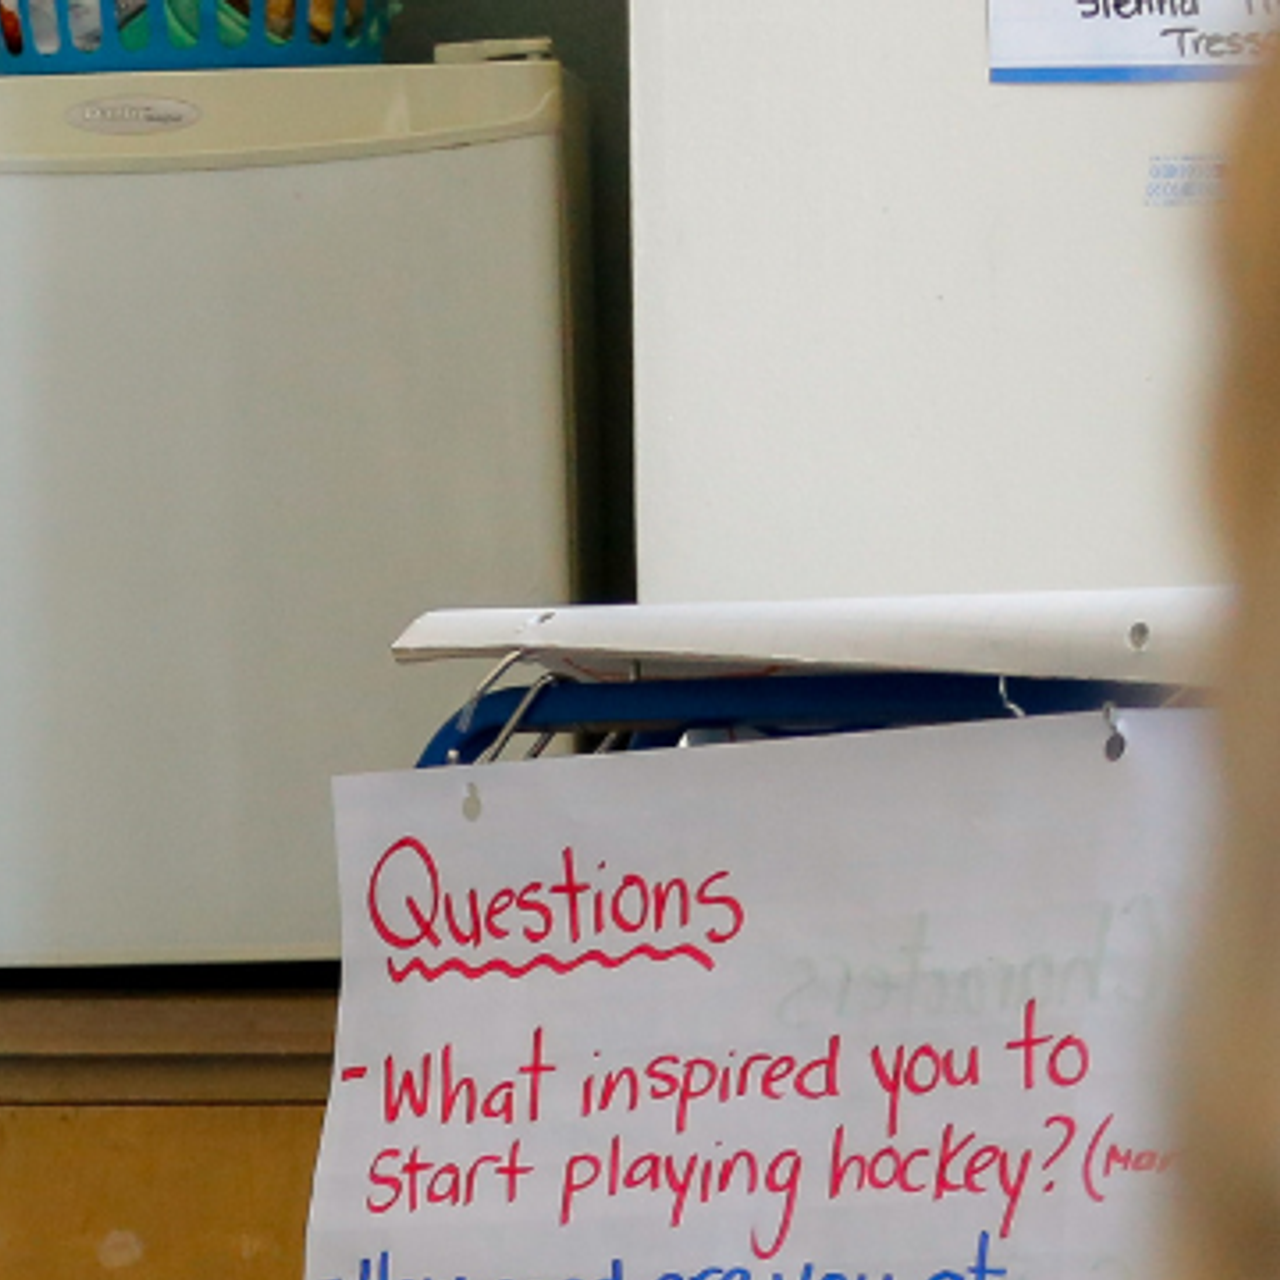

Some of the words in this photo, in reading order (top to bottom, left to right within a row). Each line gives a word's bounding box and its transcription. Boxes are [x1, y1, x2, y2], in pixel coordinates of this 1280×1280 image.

[368, 836, 745, 950] Questions
[582, 1033, 840, 1133] inspired
[871, 1041, 981, 1138] you
[1005, 998, 1090, 1091] to
[559, 1135, 803, 1260] playing
[828, 1115, 1077, 1239] hockey?
